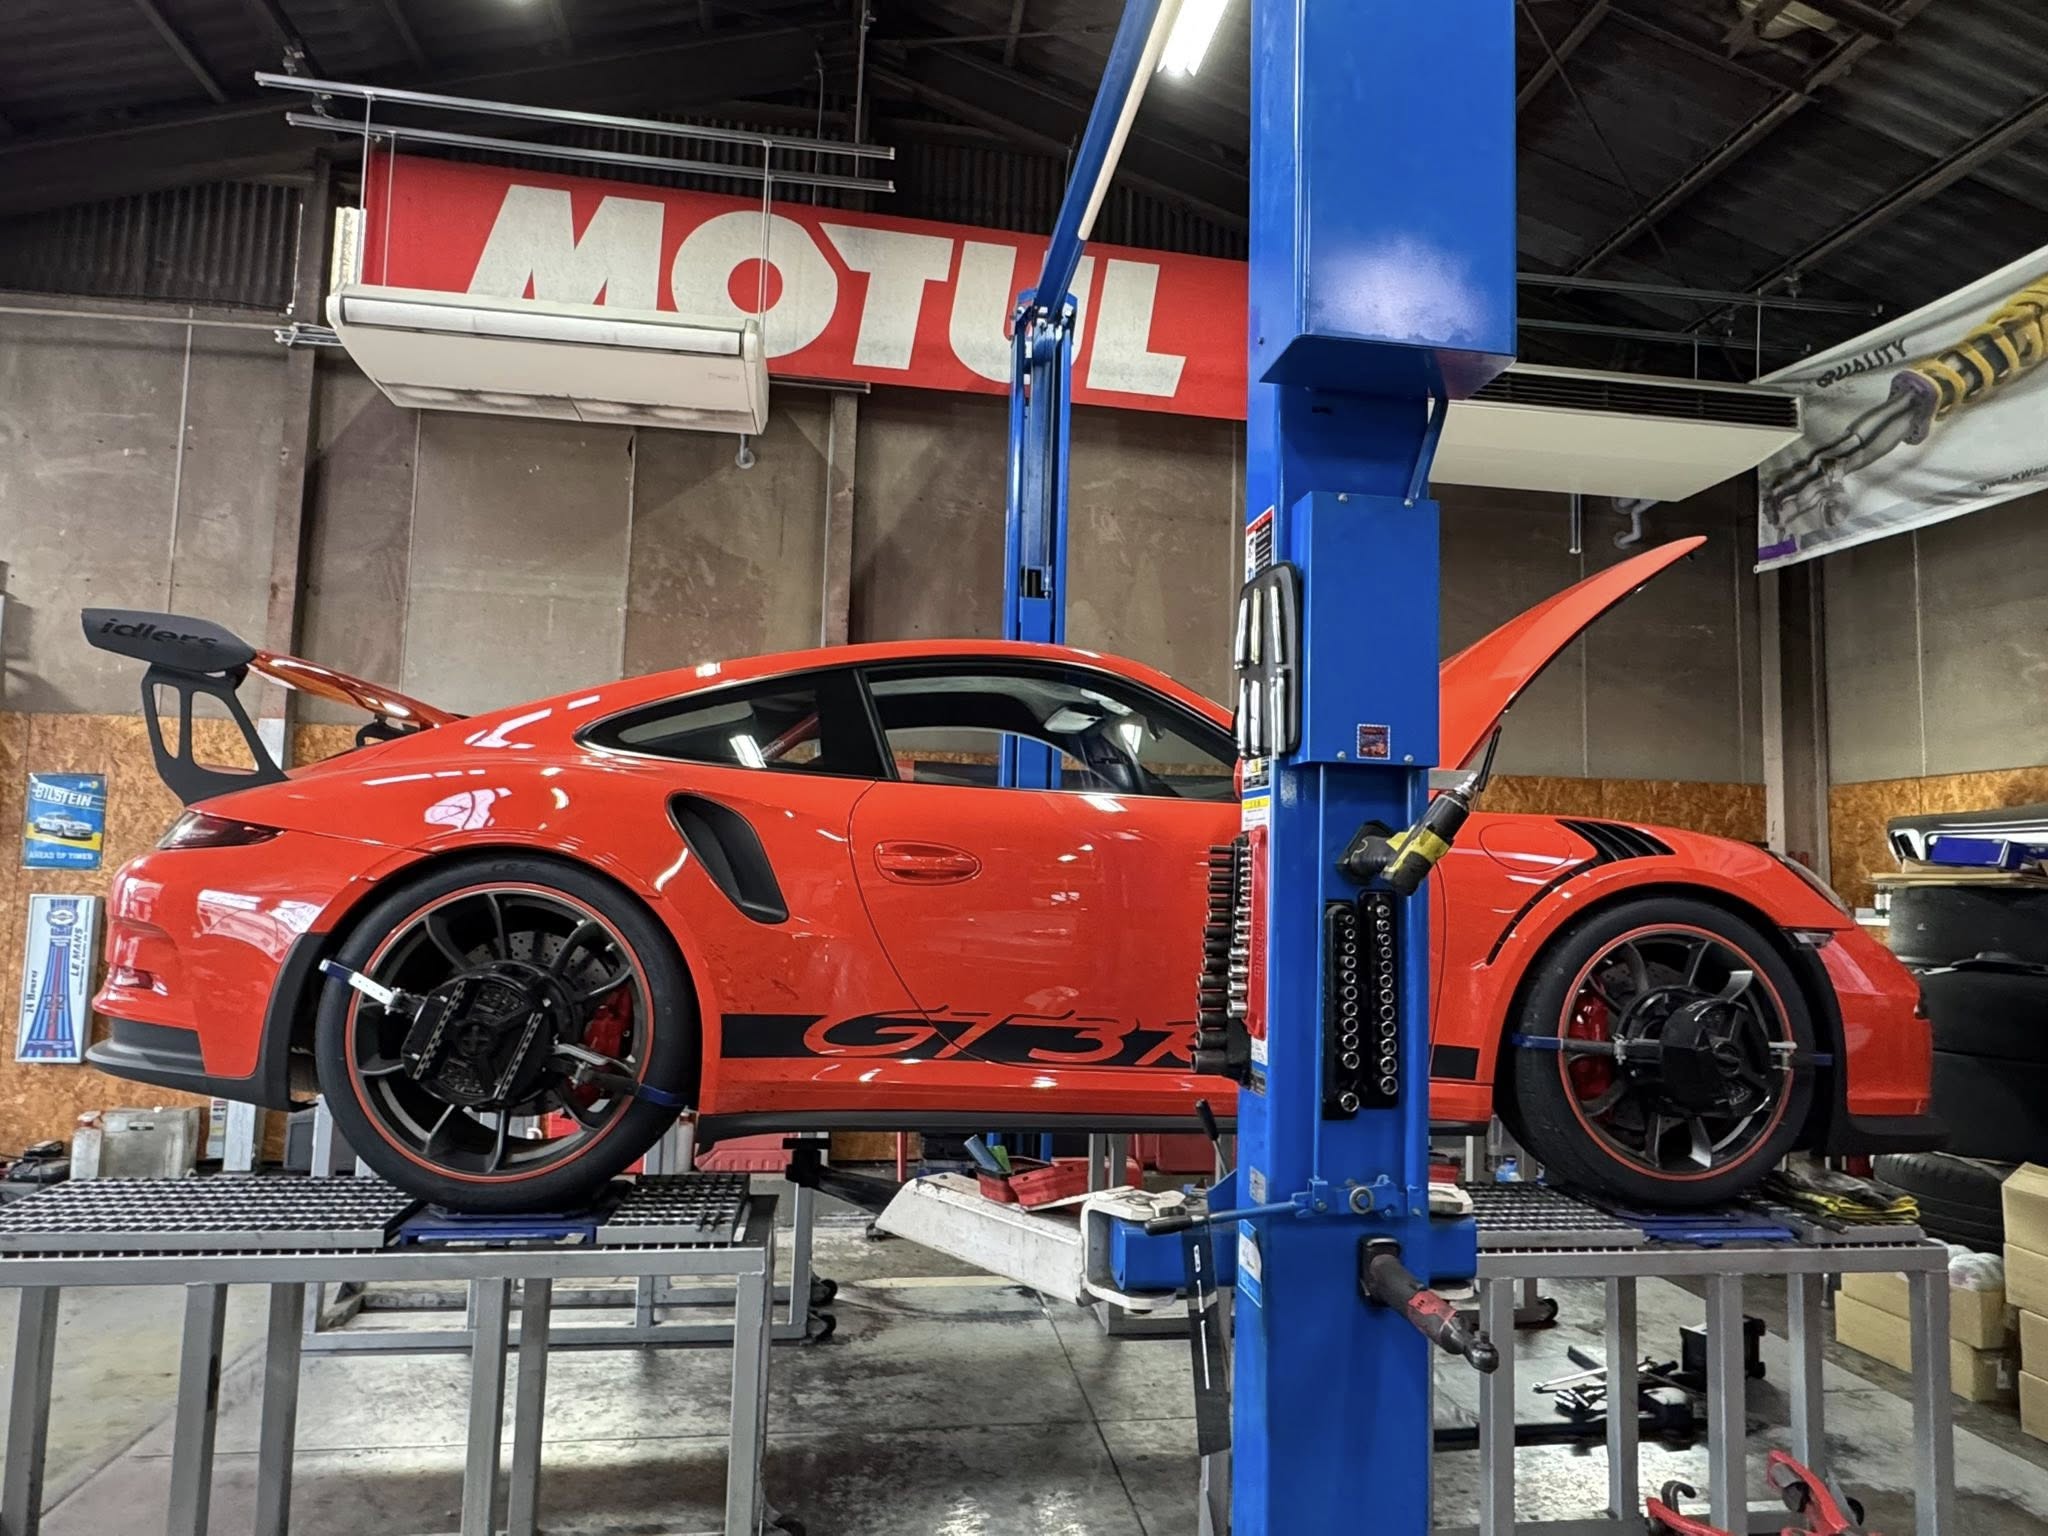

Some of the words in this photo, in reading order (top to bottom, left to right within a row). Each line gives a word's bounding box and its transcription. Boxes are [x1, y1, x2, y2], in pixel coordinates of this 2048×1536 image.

[467, 184, 1187, 398] MOTUL
[1816, 337, 1906, 389] QUALITY
[100, 618, 219, 649] idlers
[34, 784, 92, 807] BILSTEIN
[72, 927, 83, 961] MANS
[70, 962, 80, 977] LE
